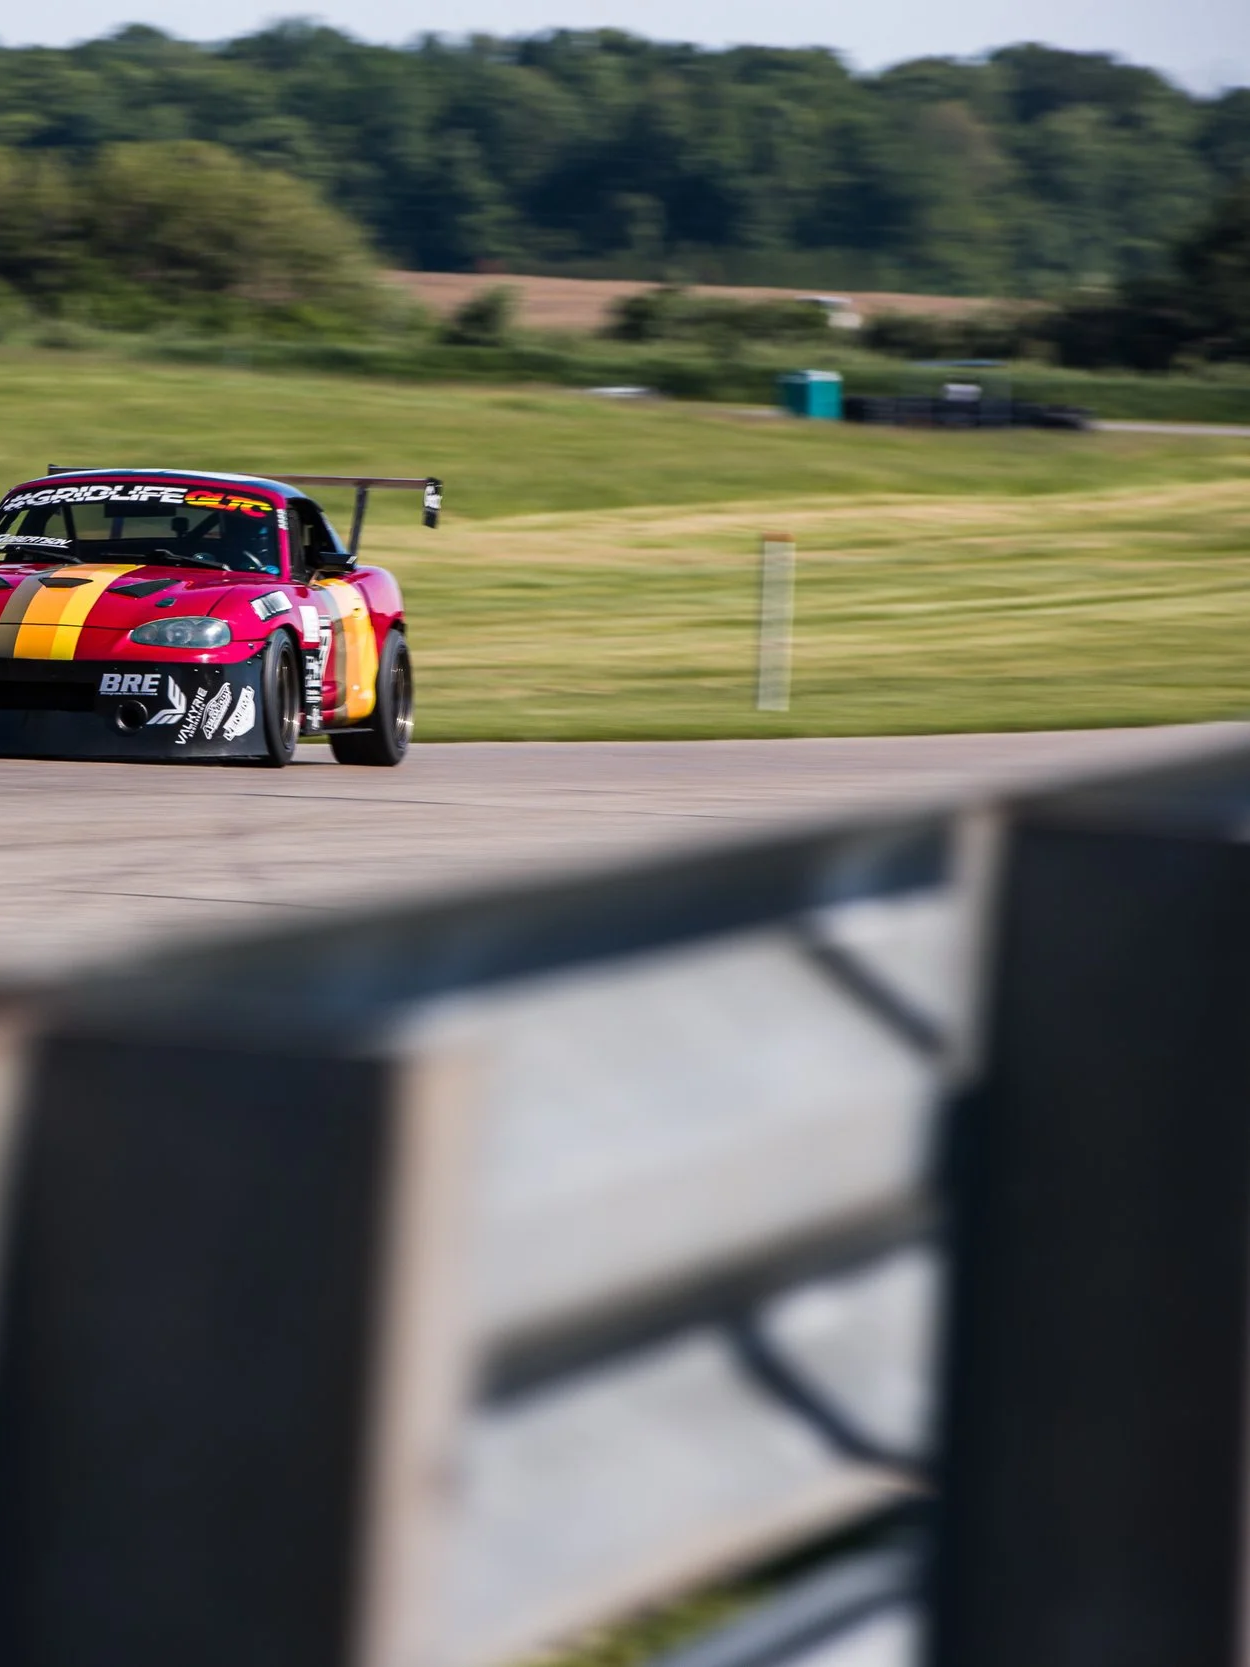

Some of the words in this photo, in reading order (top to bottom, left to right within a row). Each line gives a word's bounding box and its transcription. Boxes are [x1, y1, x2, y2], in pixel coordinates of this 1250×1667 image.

[3, 485, 188, 511] #GRIDLIFE
[184, 490, 273, 518] GLTC
[99, 673, 161, 692] BRE
[175, 686, 208, 745] VALKYRIE
